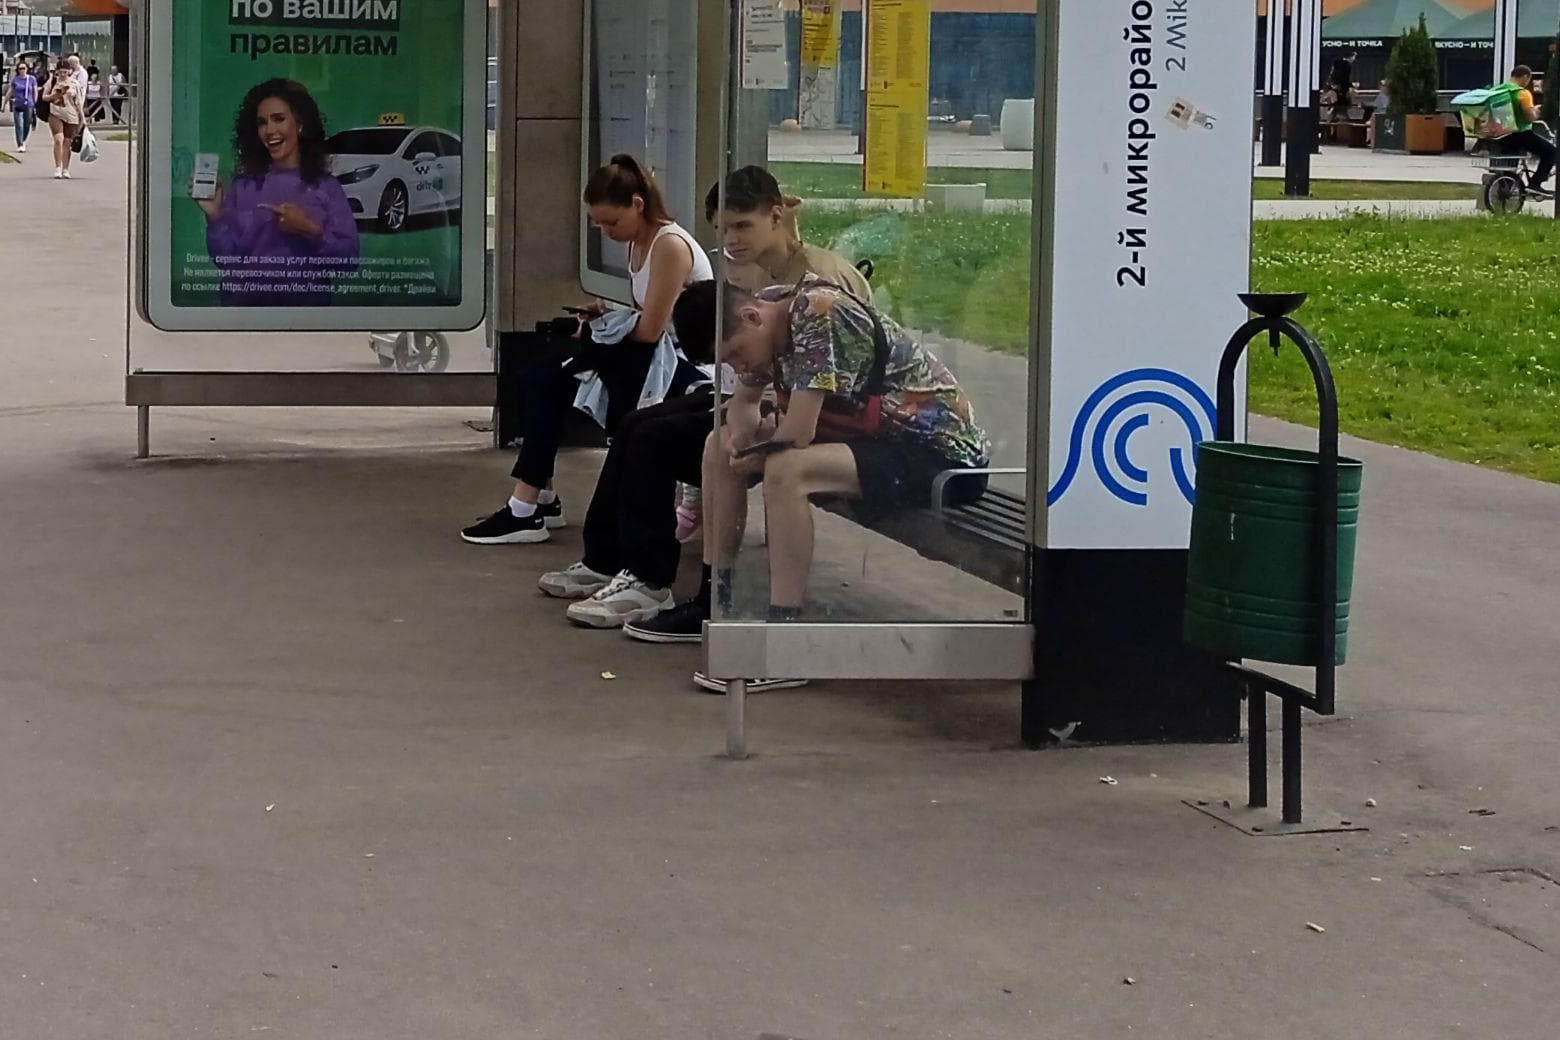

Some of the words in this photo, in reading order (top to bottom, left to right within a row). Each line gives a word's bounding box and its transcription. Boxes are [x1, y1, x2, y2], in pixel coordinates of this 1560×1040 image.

[230, 32, 398, 61] правилам
[1165, 56, 1186, 72] 2
[1116, 228, 1148, 287] 2-й
